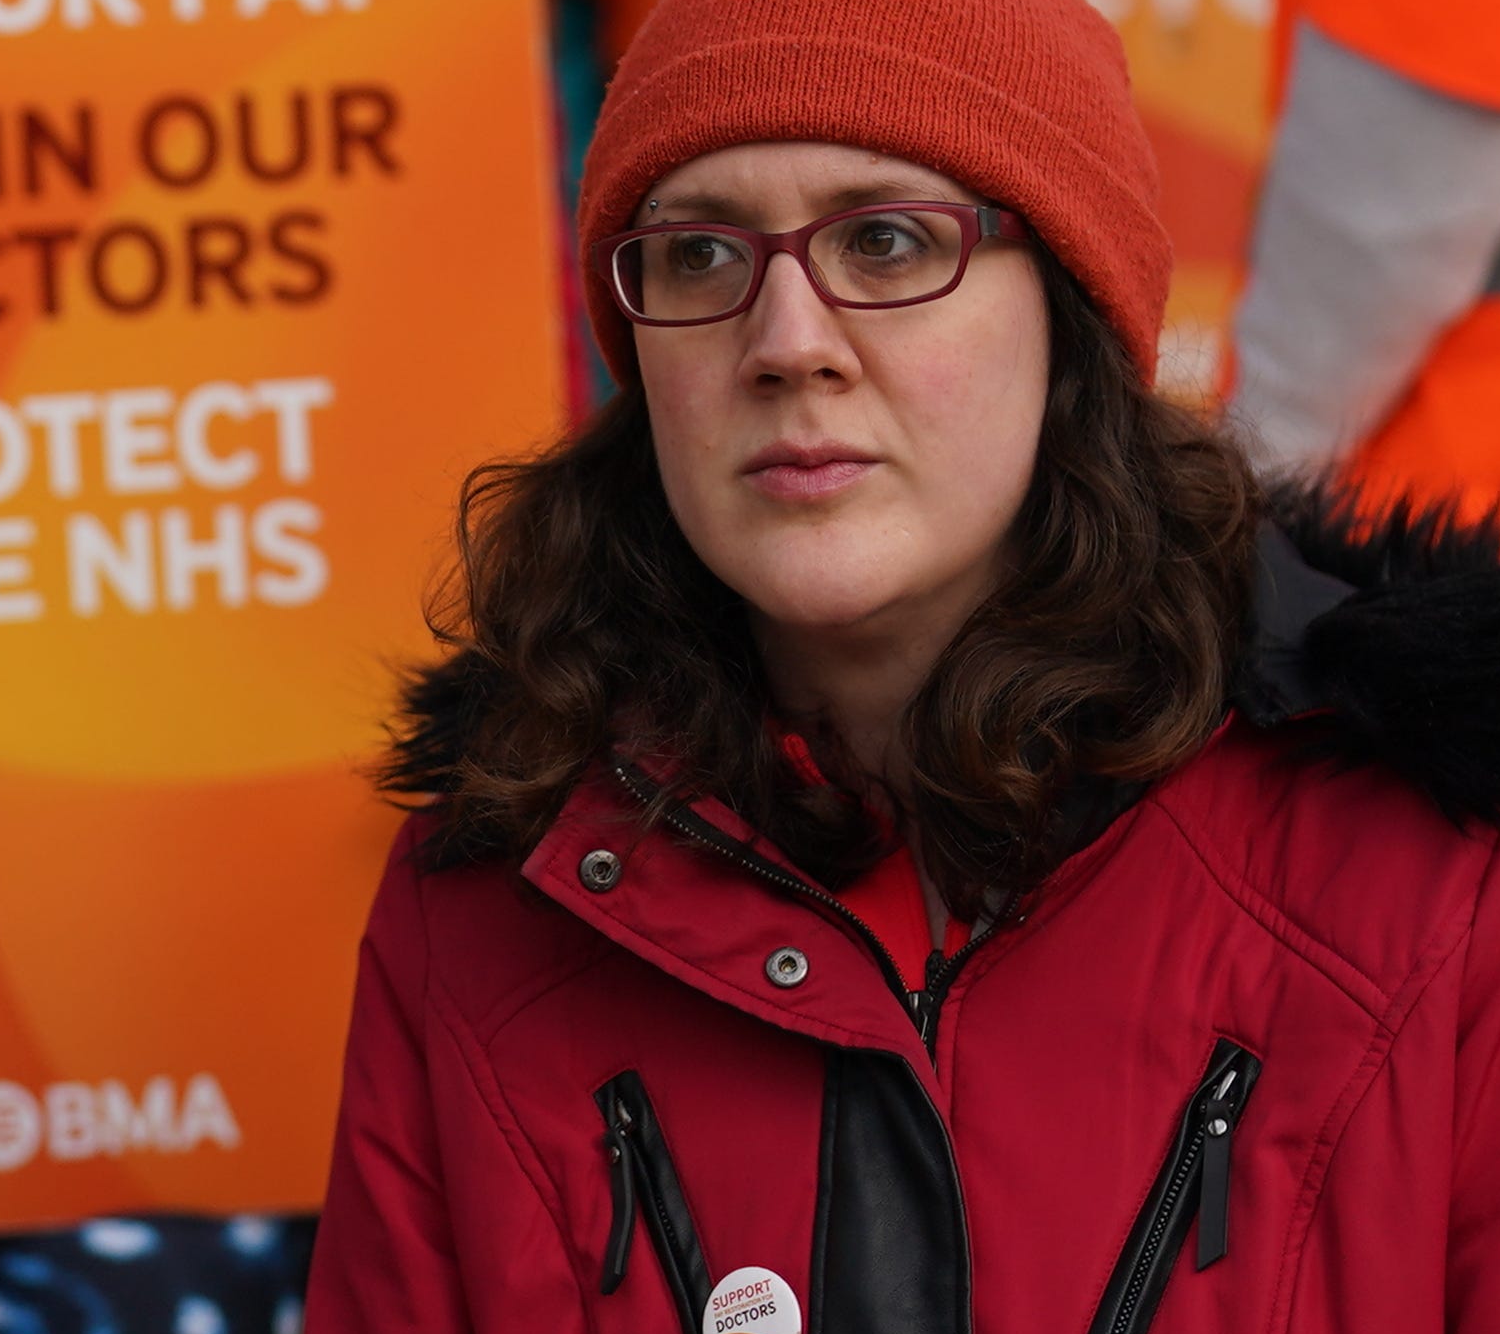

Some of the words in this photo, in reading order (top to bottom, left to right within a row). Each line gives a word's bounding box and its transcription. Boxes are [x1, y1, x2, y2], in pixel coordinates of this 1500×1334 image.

[137, 84, 406, 193] OUR
[66, 499, 329, 614] NHS
[42, 1075, 240, 1162] BMA
[712, 1278, 772, 1311] SUPPORT
[715, 1301, 777, 1334] DOCTORS
